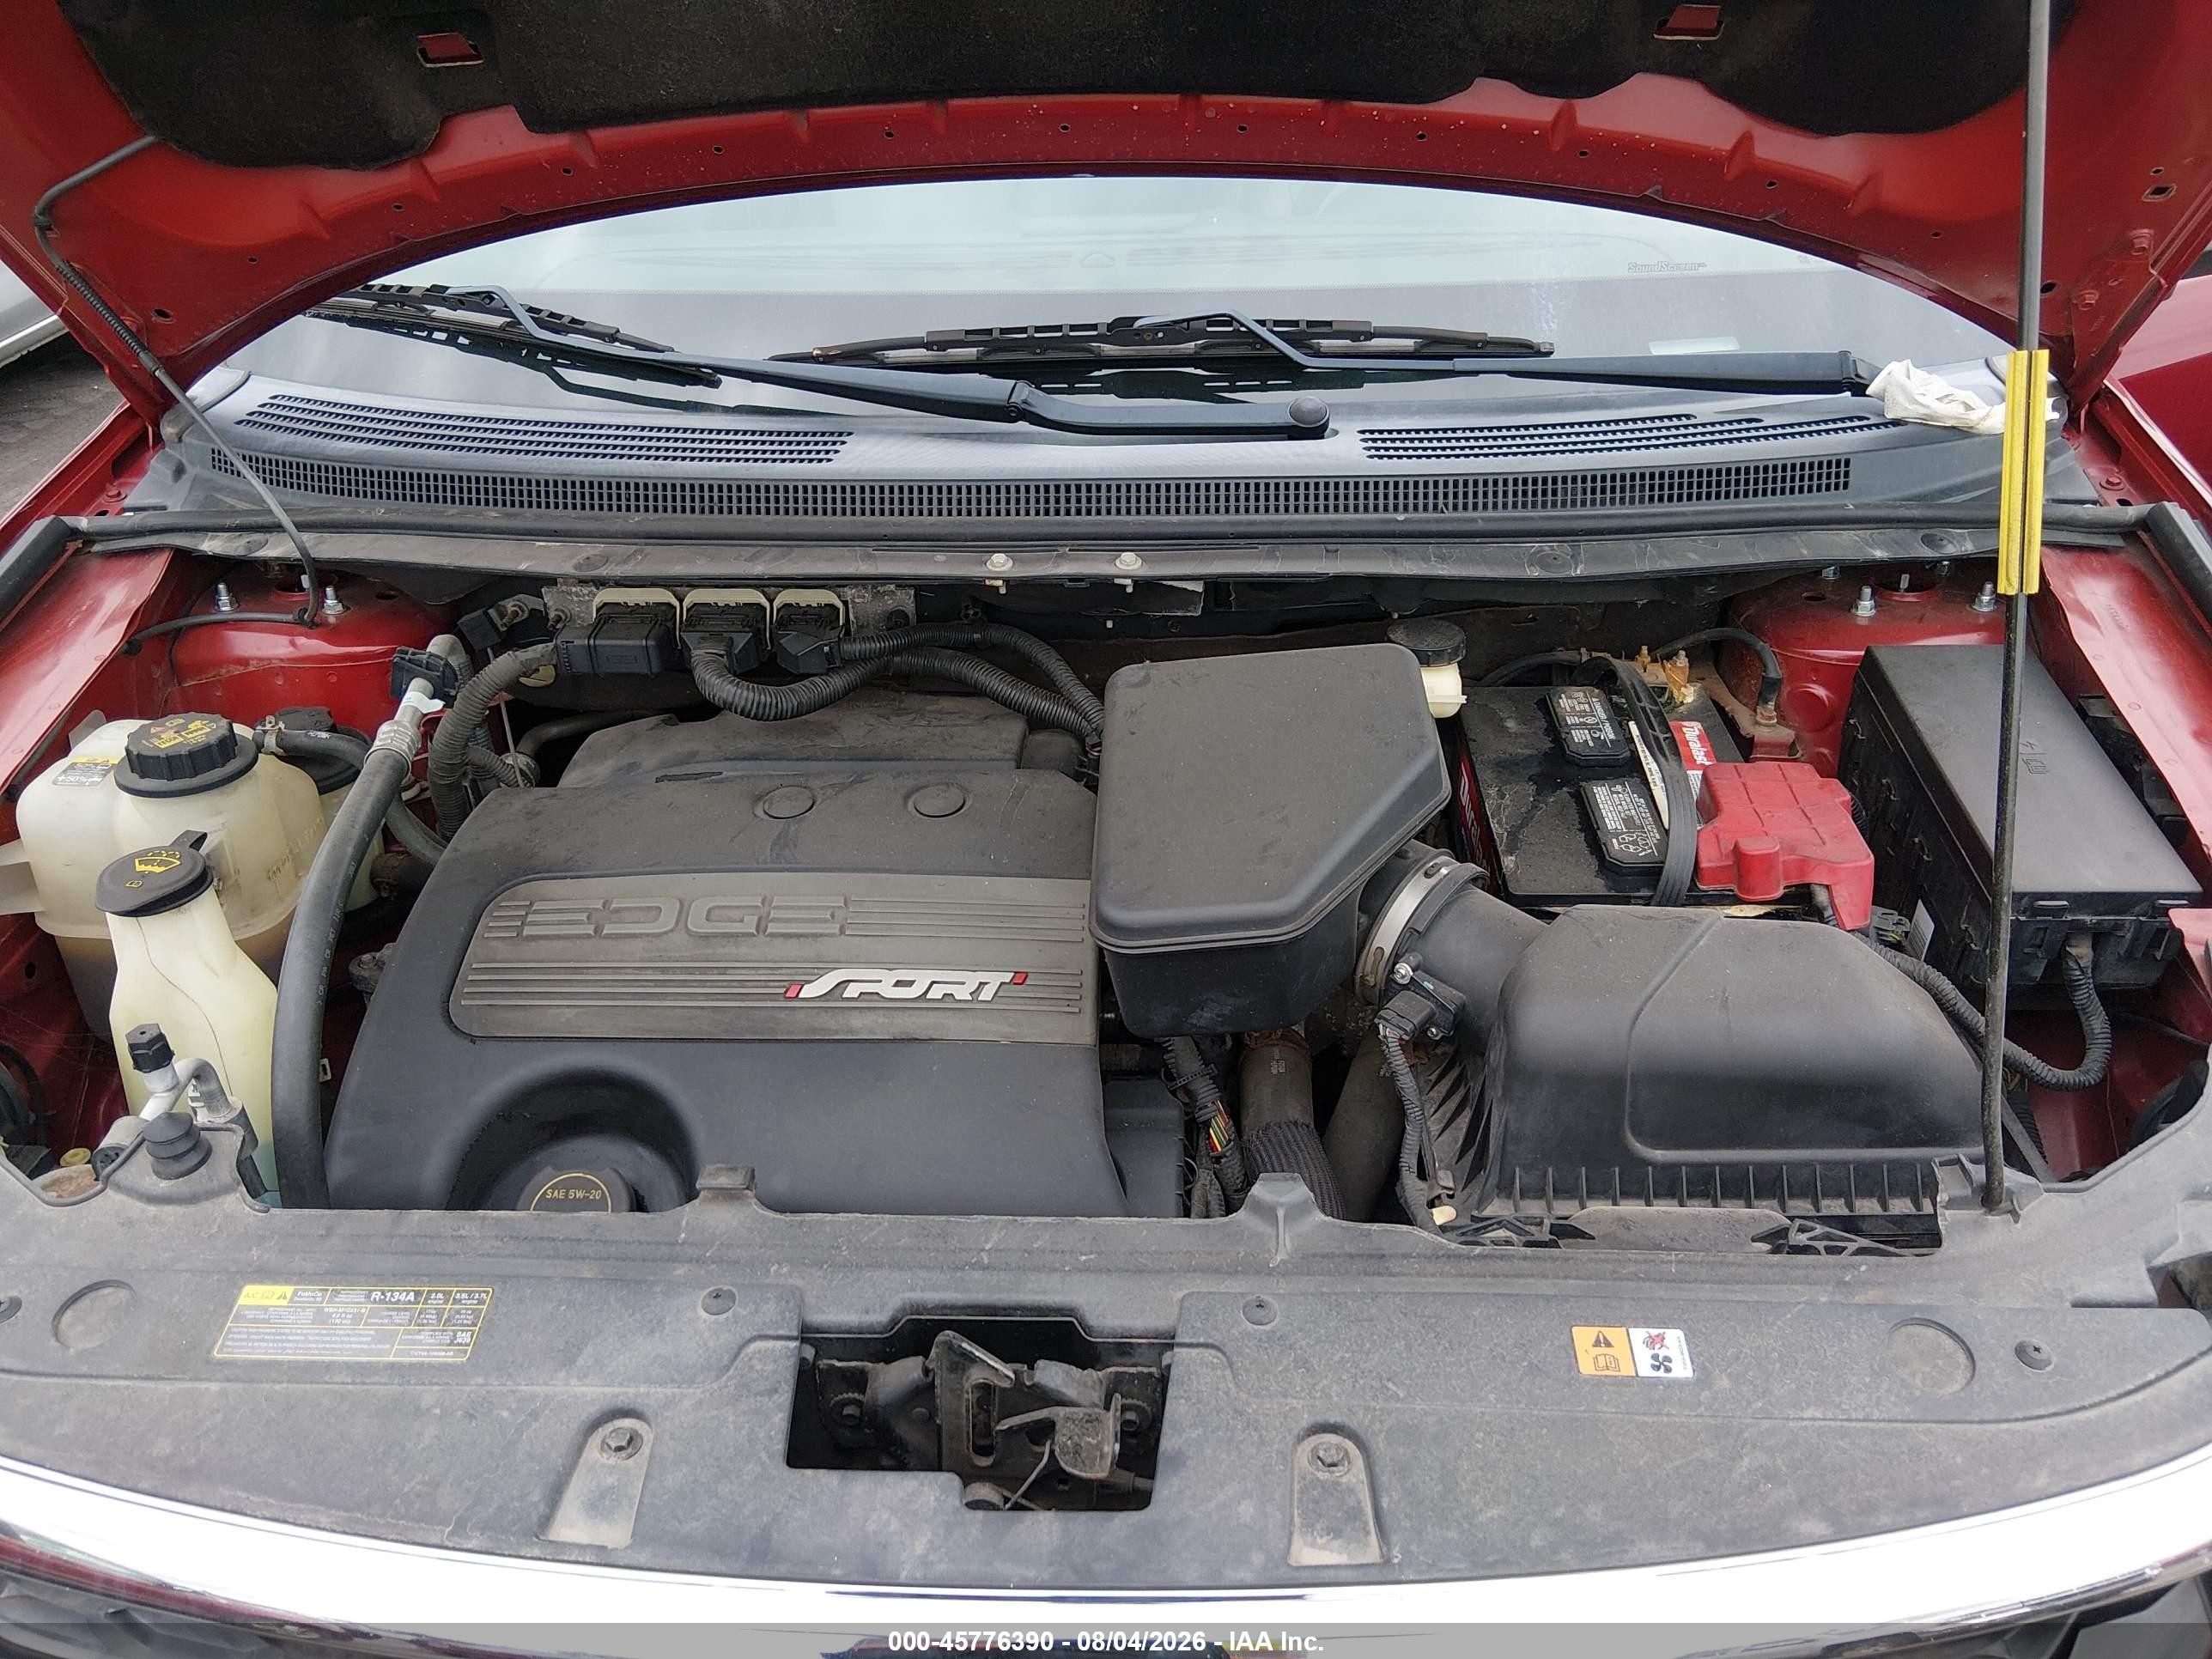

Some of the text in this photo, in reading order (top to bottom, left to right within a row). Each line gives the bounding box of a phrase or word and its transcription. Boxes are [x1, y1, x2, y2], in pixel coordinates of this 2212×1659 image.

[1681, 726, 1714, 766] Duralast
[522, 896, 846, 937] EDGE
[798, 968, 1015, 1001] SPORT
[545, 1189, 602, 1200] SAE 5W-20
[370, 1291, 415, 1303] R-134A
